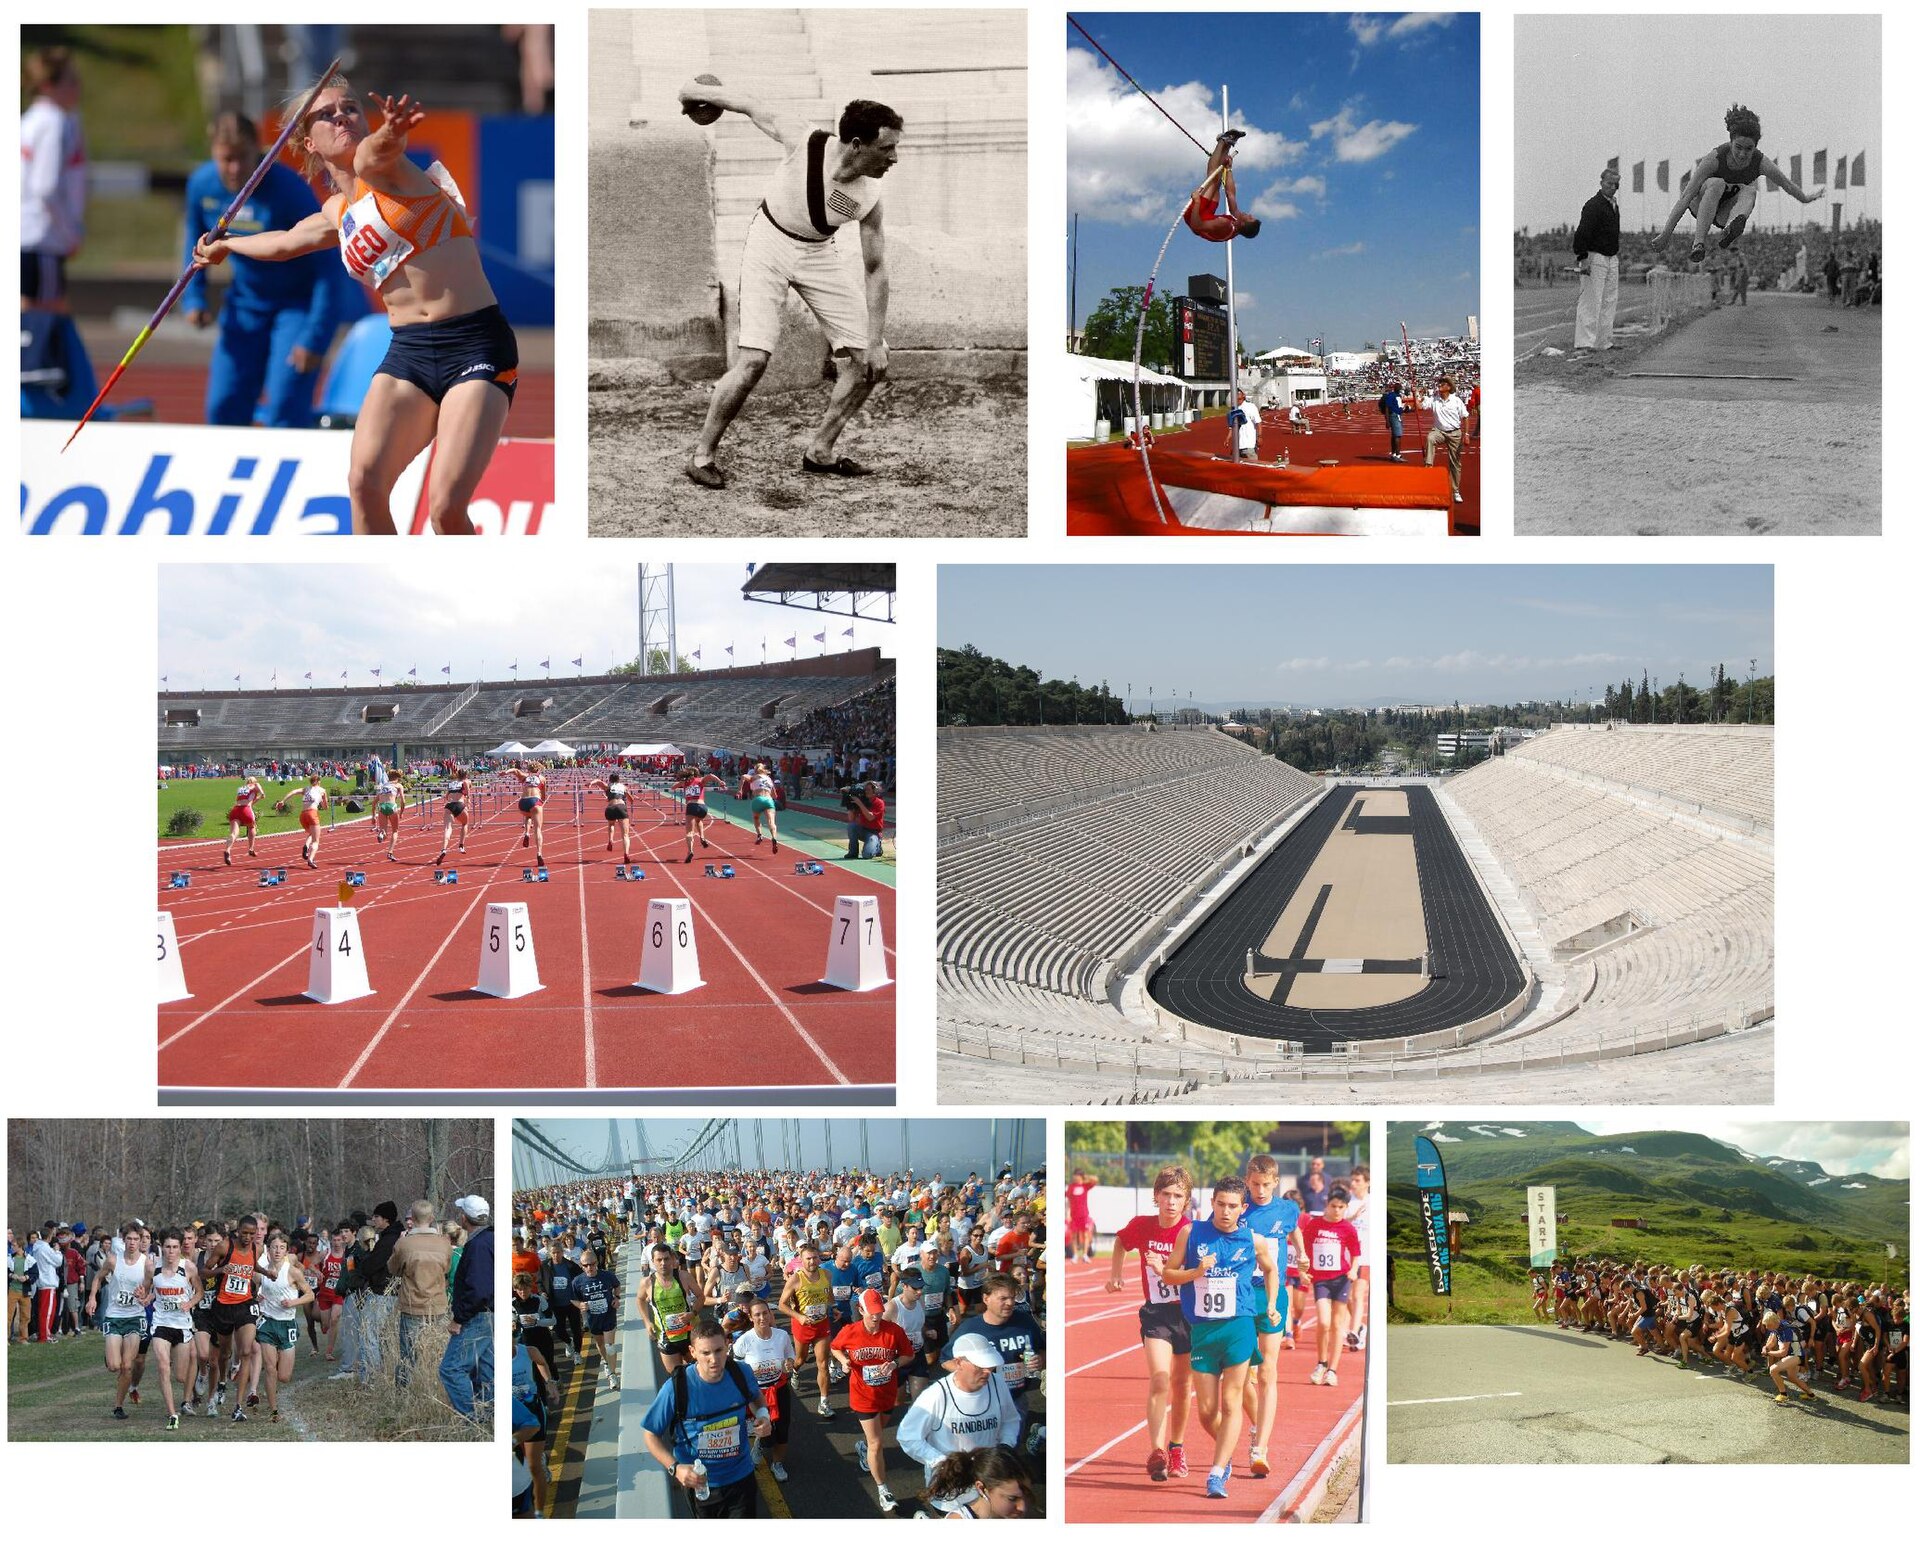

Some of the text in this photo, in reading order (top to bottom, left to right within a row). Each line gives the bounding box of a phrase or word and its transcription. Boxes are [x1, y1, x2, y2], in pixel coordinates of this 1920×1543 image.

[489, 924, 526, 953] 5 5
[652, 920, 688, 948] 6 6
[840, 917, 874, 945] 7 7
[316, 930, 352, 958] 4 4
[1537, 1192, 1547, 1247] START
[1148, 1240, 1174, 1252] FIDAL
[1319, 1254, 1334, 1267] 93
[229, 1279, 246, 1290] 511
[1203, 1293, 1226, 1313] 99
[706, 1430, 724, 1439] ING
[951, 1417, 998, 1434] RANDBURG
[707, 1435, 731, 1447] 38274
